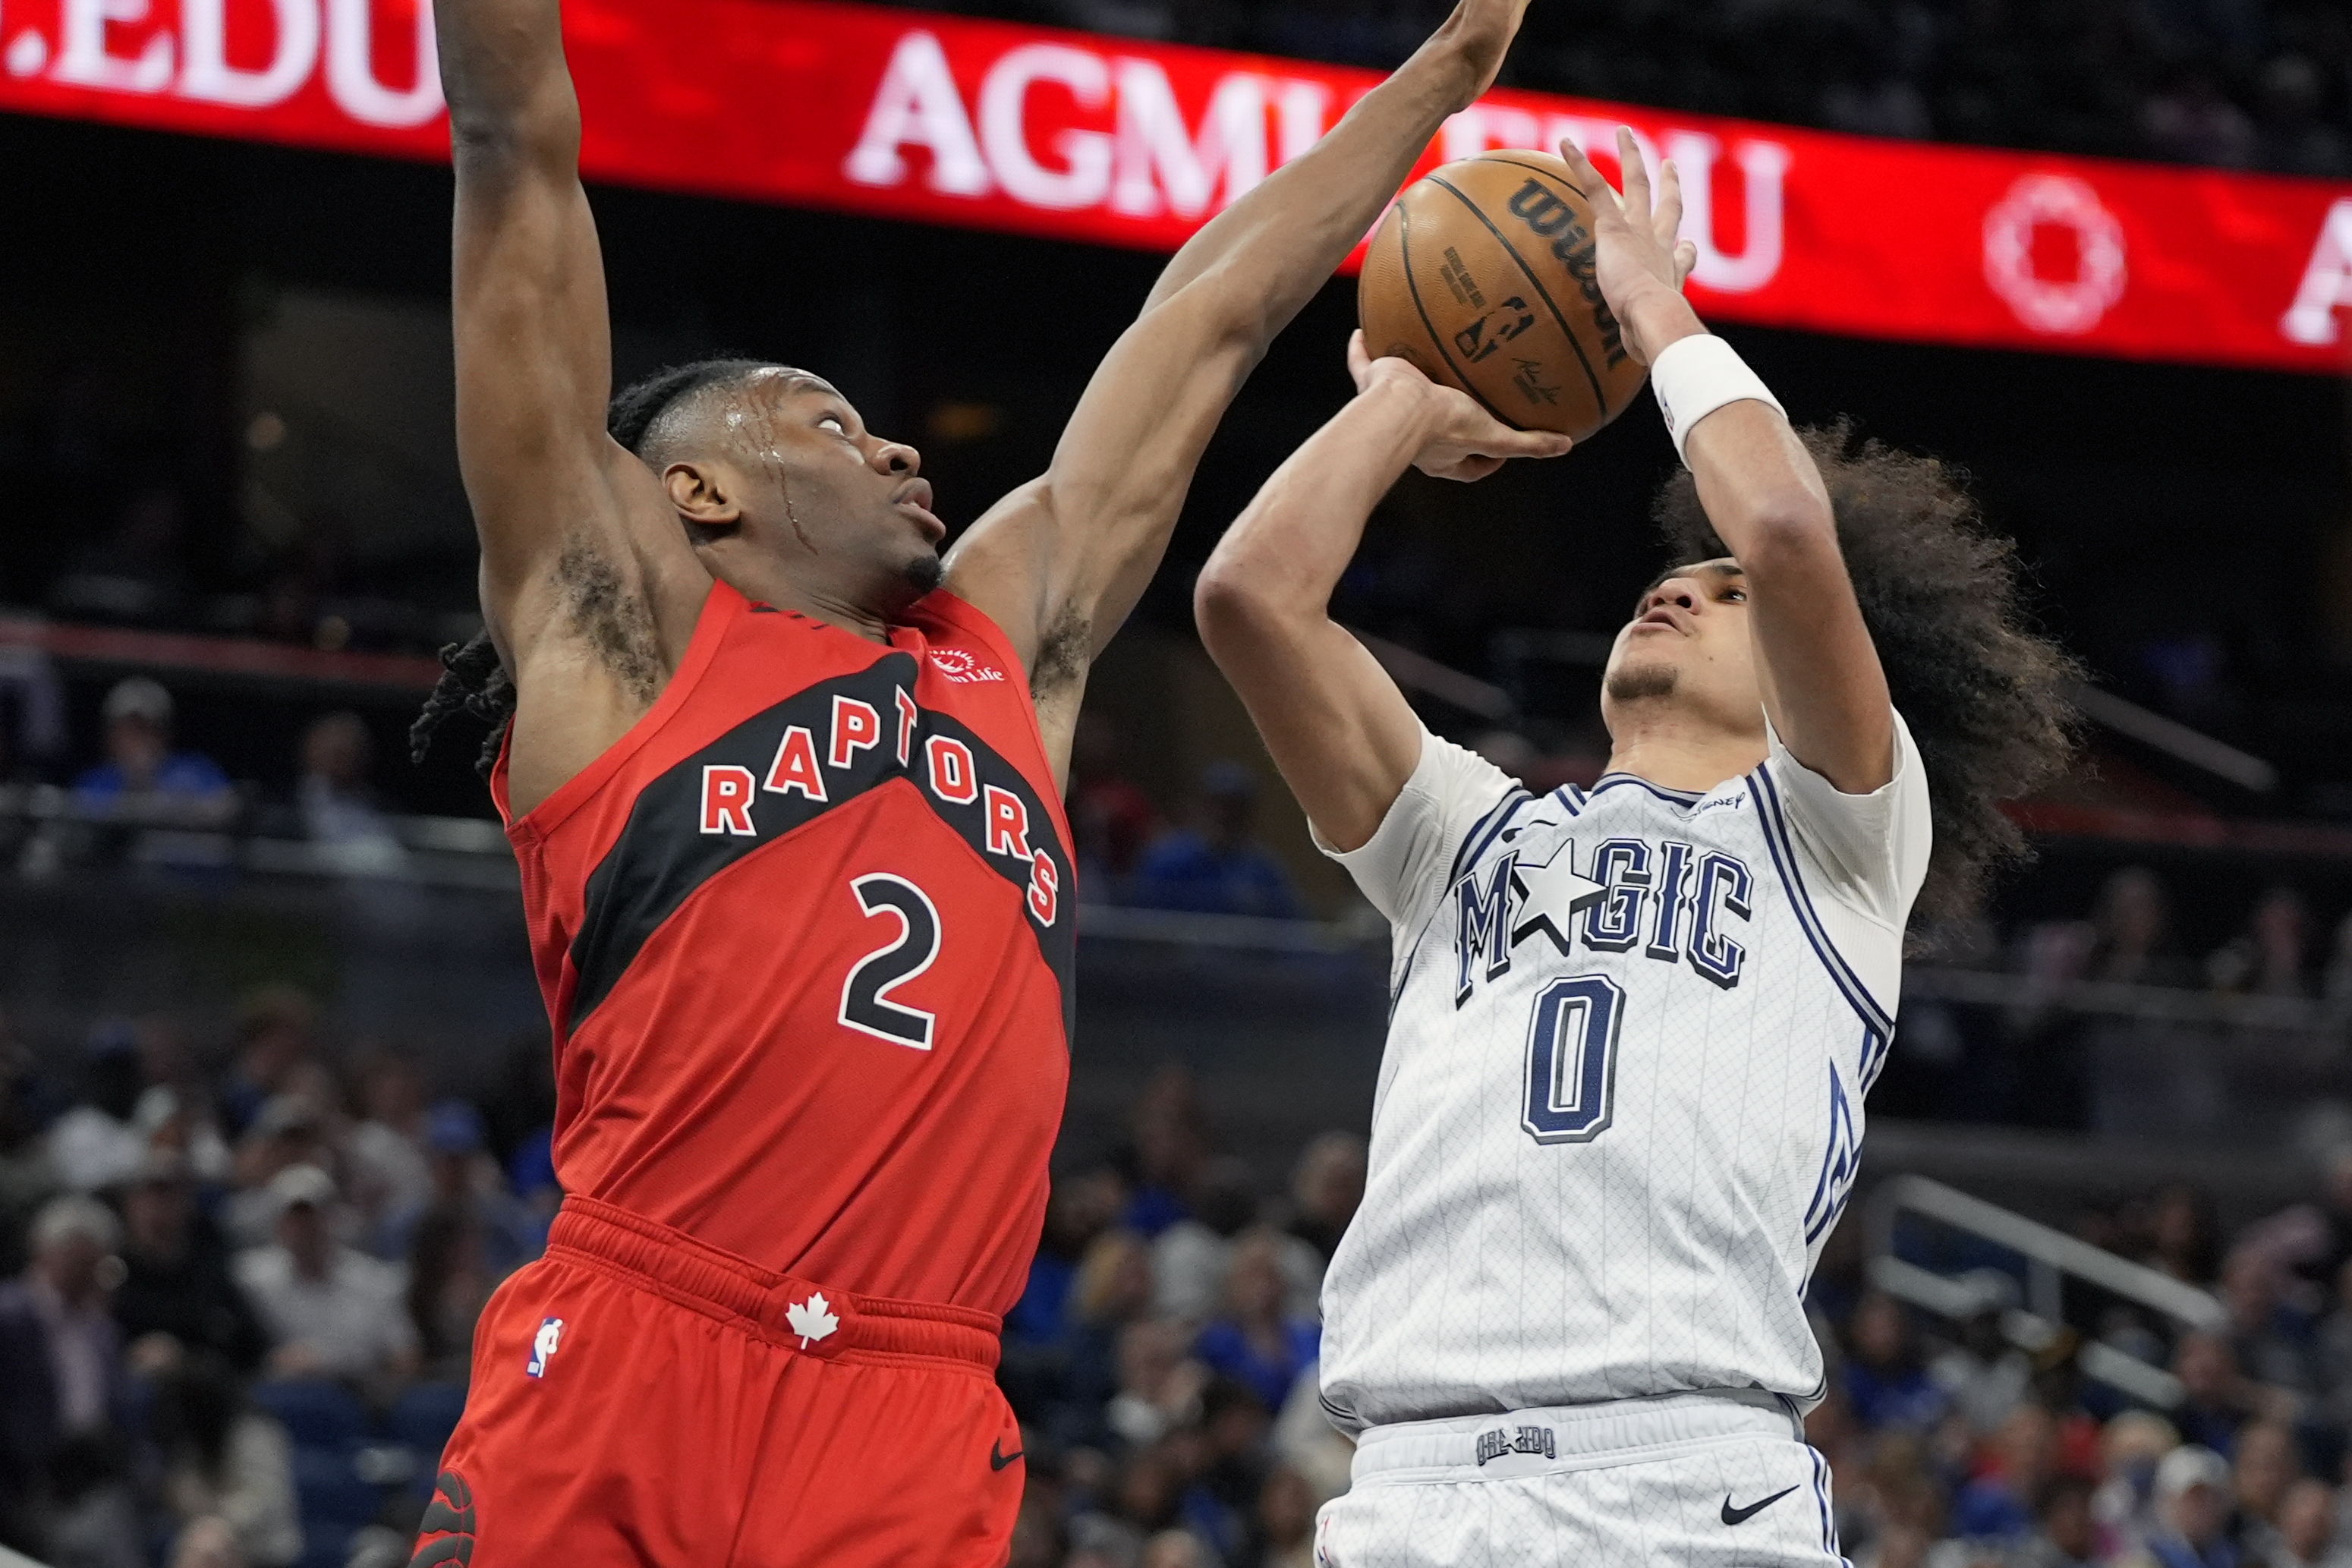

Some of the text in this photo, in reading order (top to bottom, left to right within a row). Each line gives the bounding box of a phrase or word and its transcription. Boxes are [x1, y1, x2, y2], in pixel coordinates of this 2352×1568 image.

[965, 666, 1005, 682] Life
[700, 684, 1058, 927] RAPTORS
[837, 871, 942, 1050] 2
[1520, 974, 1626, 1145] 0
